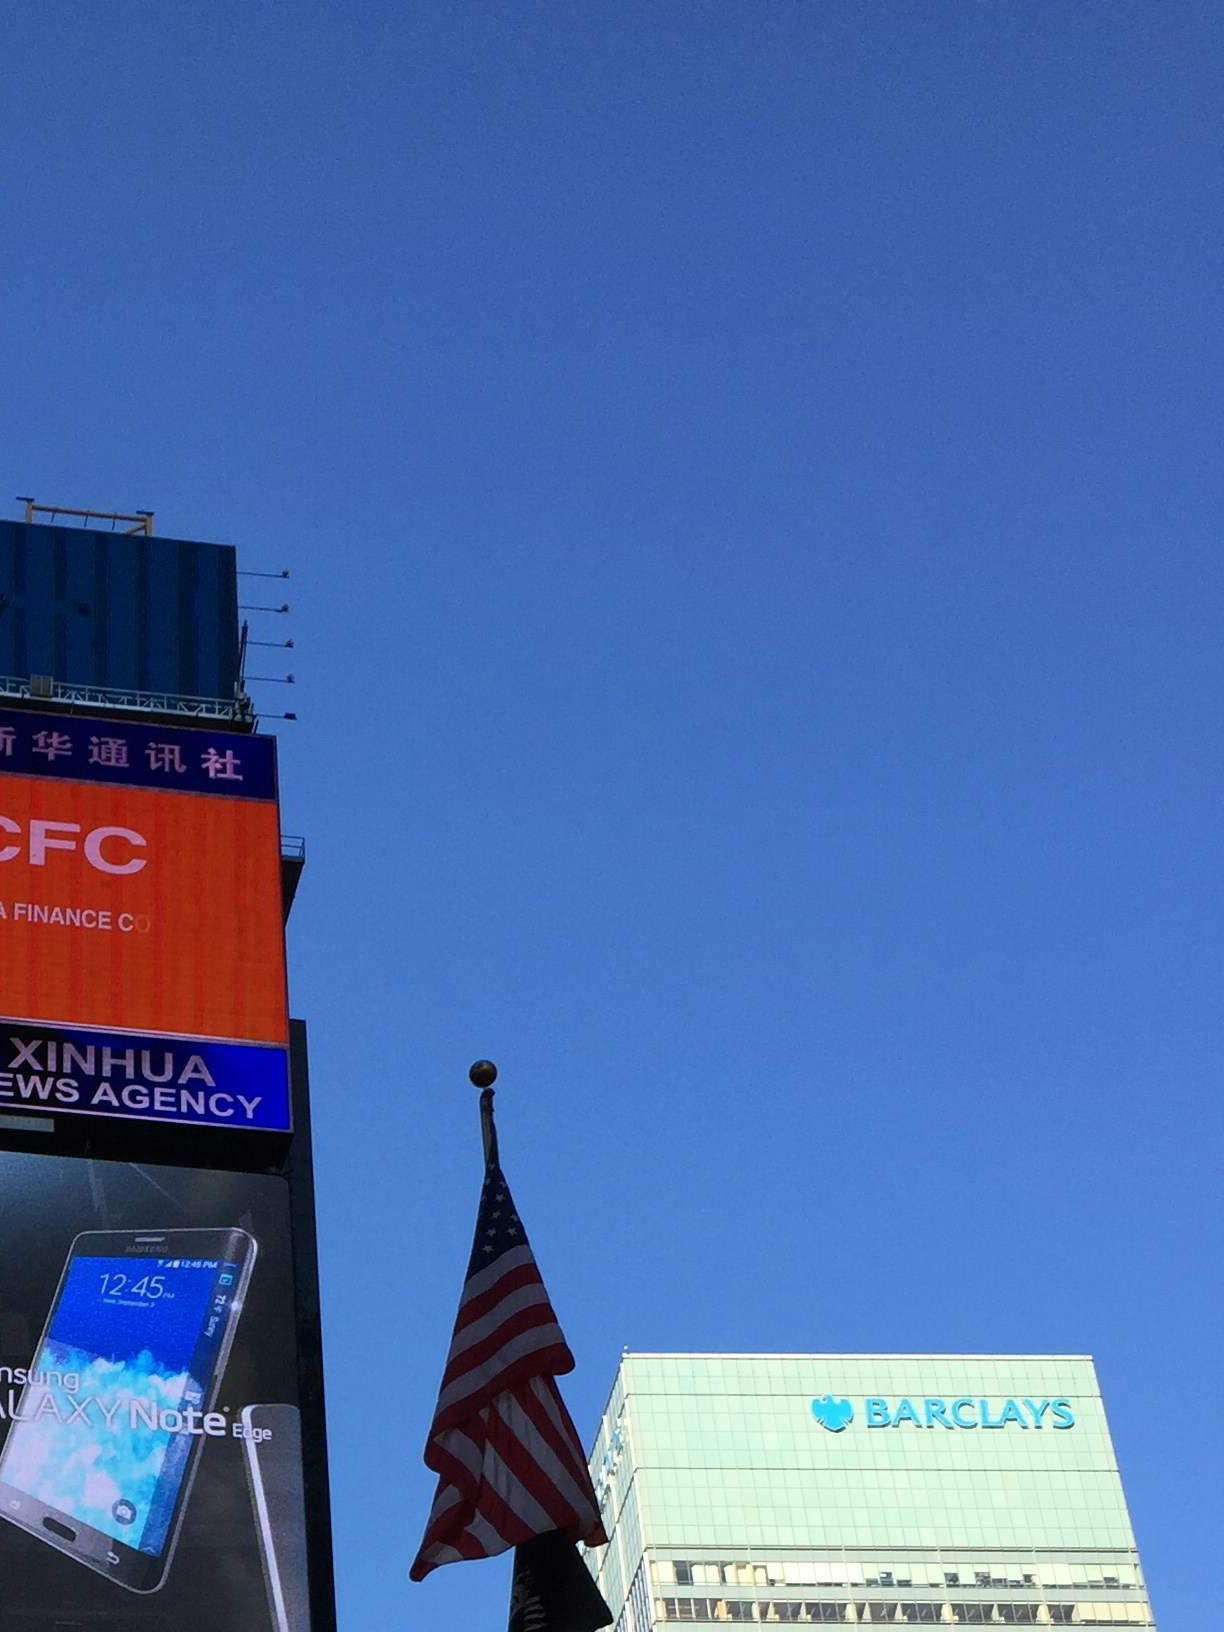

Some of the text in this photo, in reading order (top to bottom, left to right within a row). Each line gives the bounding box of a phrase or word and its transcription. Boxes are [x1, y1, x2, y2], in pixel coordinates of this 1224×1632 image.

[13, 903, 112, 930] FINANCE
[9, 1037, 216, 1087] XINHUA
[90, 1085, 263, 1119] AGENCY
[99, 1272, 166, 1299] 12:45
[130, 1402, 227, 1437] Note
[232, 1422, 273, 1444] Edge
[865, 1397, 1075, 1429] BARCLAYS
